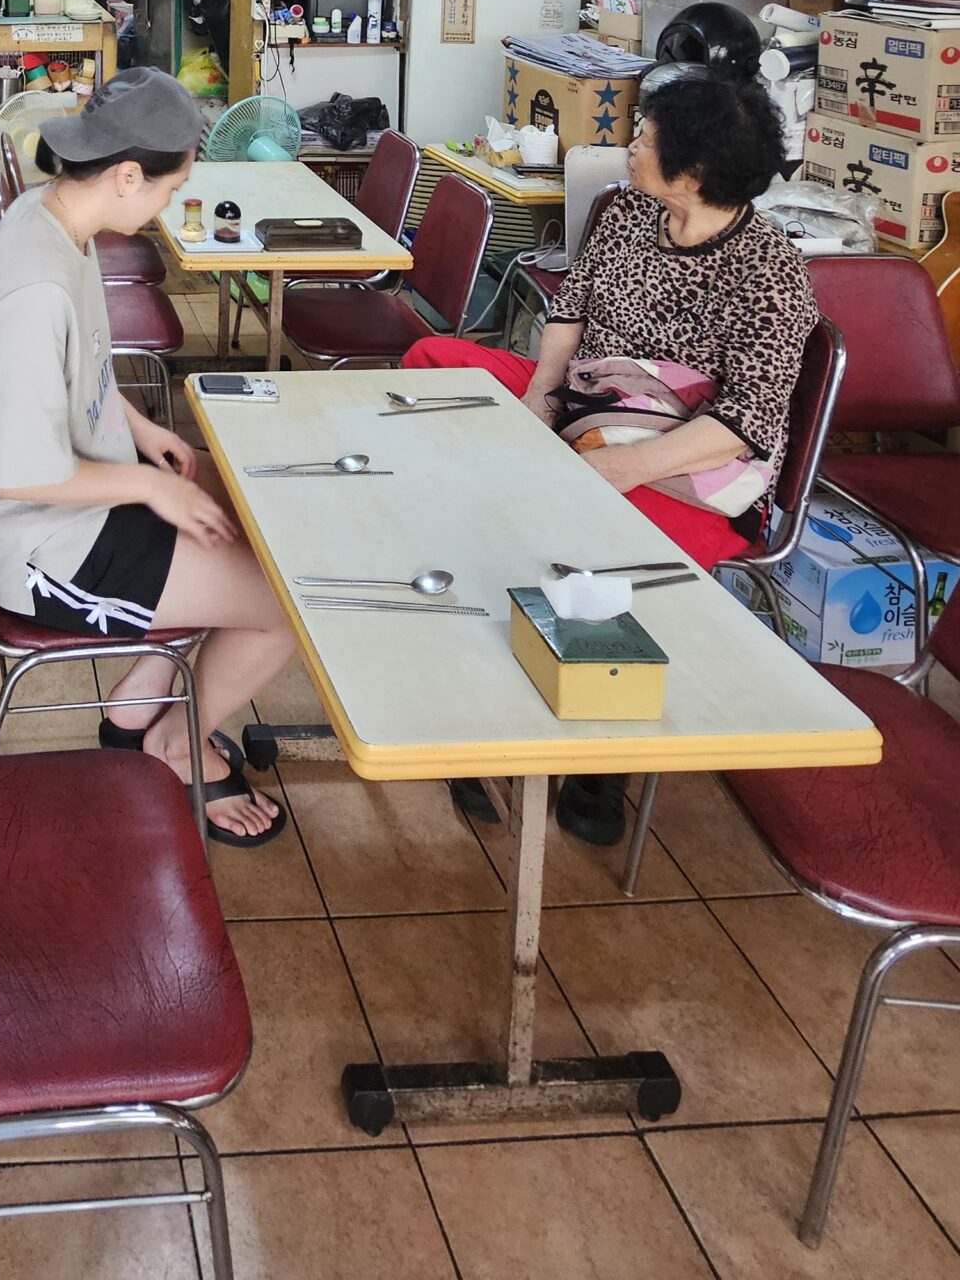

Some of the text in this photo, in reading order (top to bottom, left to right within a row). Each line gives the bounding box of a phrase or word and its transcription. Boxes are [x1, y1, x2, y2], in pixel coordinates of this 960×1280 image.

[833, 34, 859, 49] 농심
[887, 40, 923, 57] 멀티팩
[855, 57, 897, 108] 辛
[889, 93, 918, 107] 라면
[821, 132, 845, 149] 농심
[871, 146, 907, 167] 멀티팩
[884, 583, 907, 606] 참
[884, 603, 916, 627] 이슬
[881, 627, 915, 642] fresh
